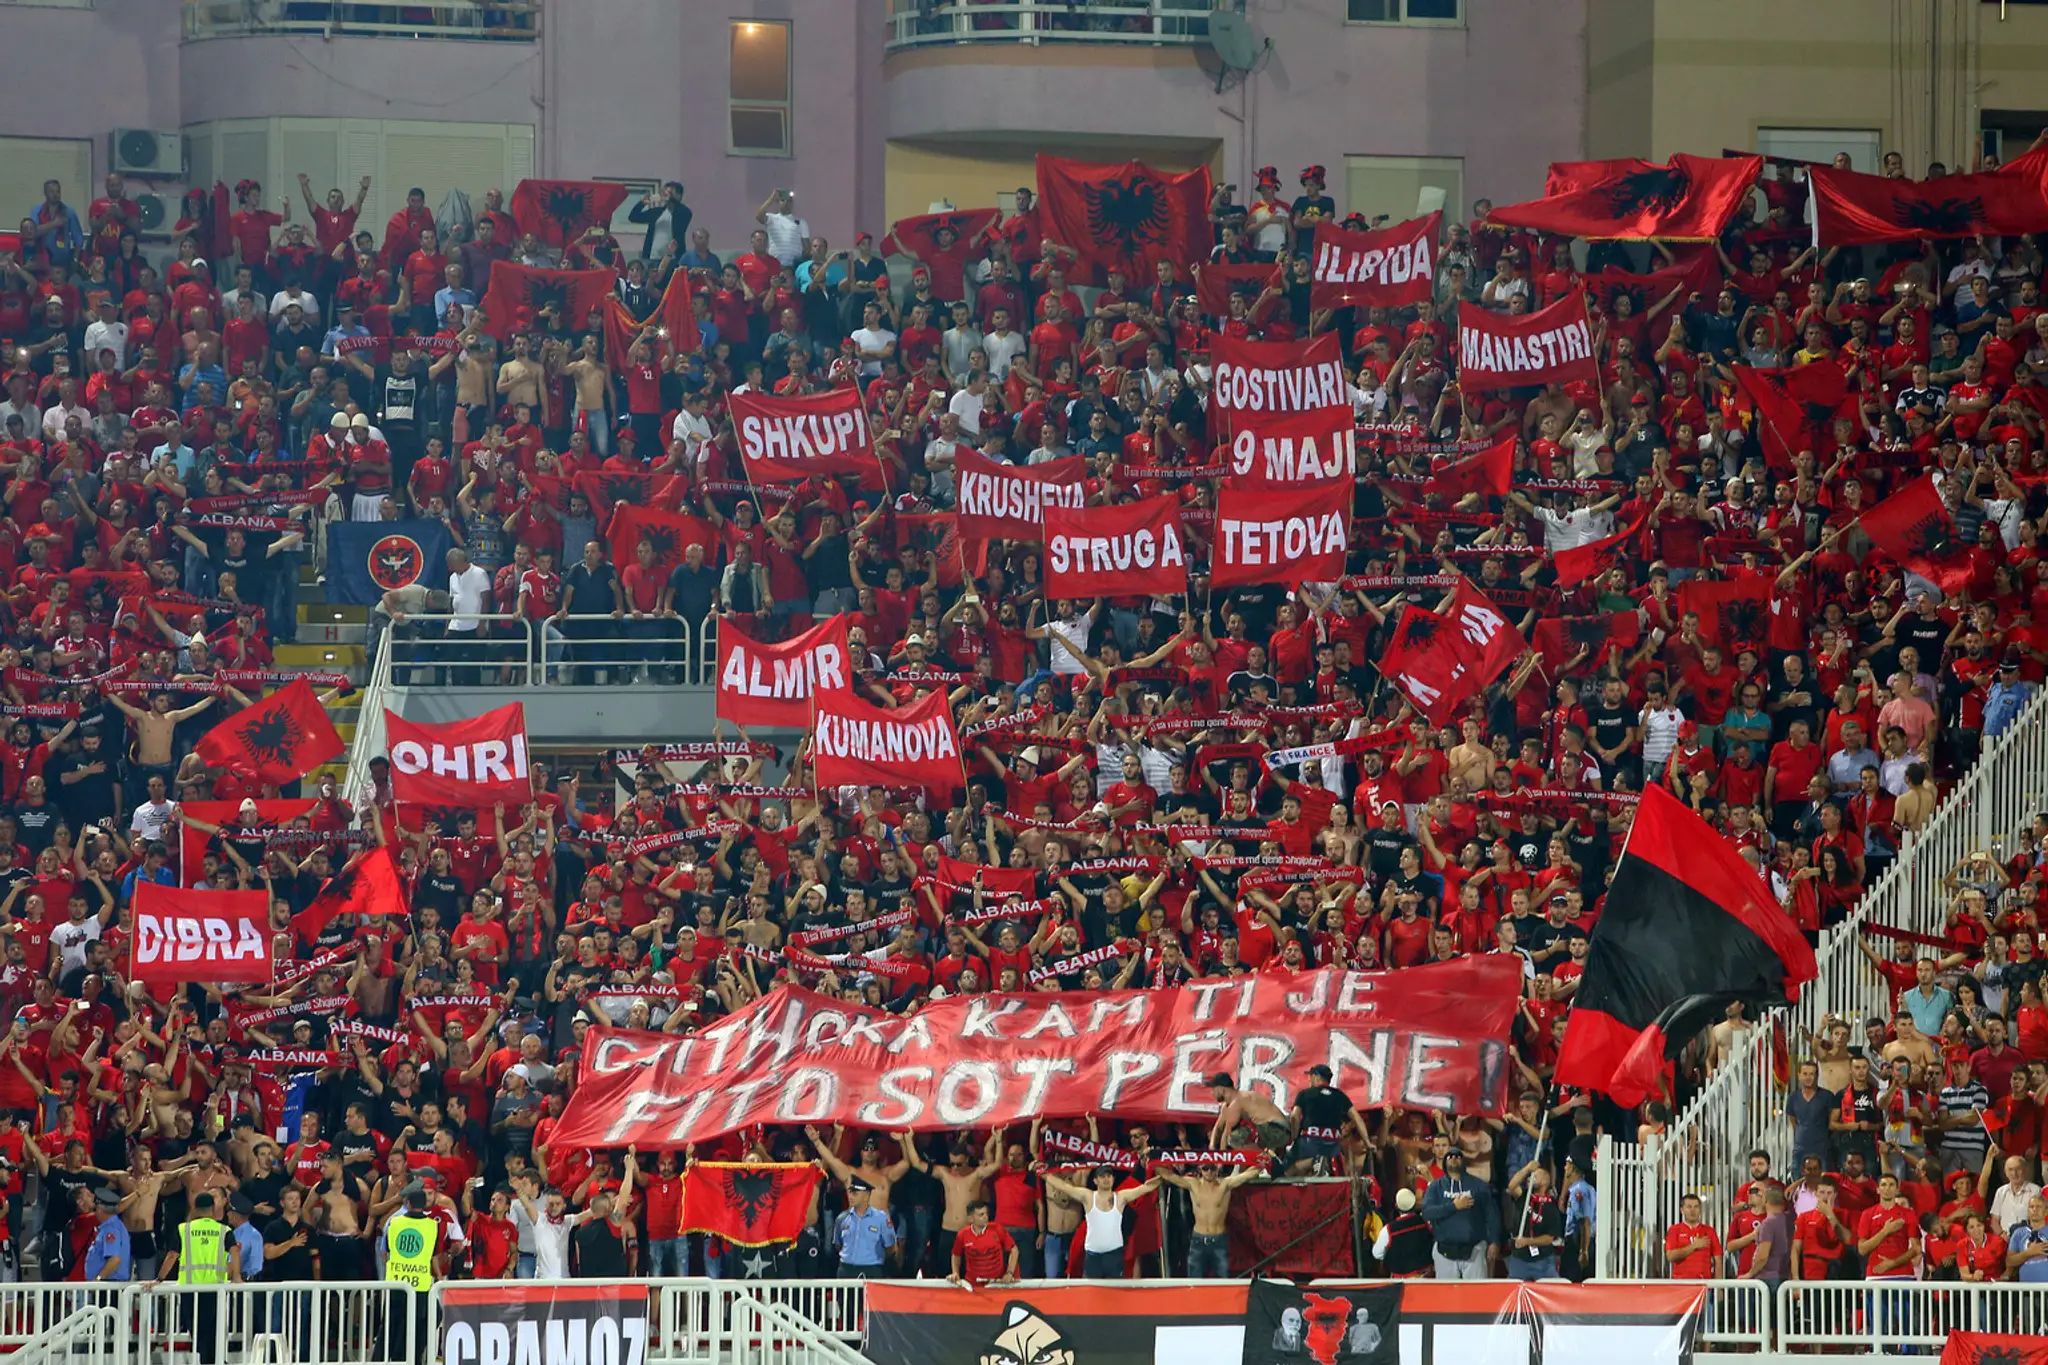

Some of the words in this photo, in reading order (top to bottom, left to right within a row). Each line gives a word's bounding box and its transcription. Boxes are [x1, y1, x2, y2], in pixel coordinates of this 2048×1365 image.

[1461, 319, 1592, 372] MANASTIRI
[1216, 360, 1345, 413] GOSTIVARI
[742, 406, 867, 461] SHKUPI
[1355, 422, 1412, 432] LBANIA
[1232, 432, 1256, 477] 9
[1264, 428, 1355, 482] MAJI
[1391, 473, 1434, 483] ALBA
[199, 514, 276, 528] ALBANIA
[1050, 522, 1184, 574] STRUGA
[1220, 510, 1346, 565] TETOVA
[721, 643, 845, 699] ALMIR
[886, 671, 962, 682] ALBANIA
[815, 709, 957, 762] KUMANOVA
[966, 709, 1037, 737] ALBANIA
[391, 732, 528, 785] OHRI
[664, 742, 751, 755] ALBANIA
[1370, 794, 1382, 816] 5
[1070, 858, 1150, 871] ALBANIA
[964, 900, 1043, 921] ALBANIA
[137, 914, 265, 964] DIBRA
[274, 952, 338, 983] LBANIA
[1028, 944, 1120, 982] ALBANIA
[411, 995, 492, 1008] ALBANIA
[599, 984, 679, 997] ALBANIA
[961, 994, 1149, 1038] KAM
[1188, 977, 1258, 1020] TI
[1286, 970, 1385, 1014] JE
[329, 1019, 410, 1045] ALBANIA
[248, 1049, 329, 1063] ALBANIA
[858, 1056, 1074, 1125] SOT
[1045, 1130, 1131, 1161] ALBANIA
[1160, 1150, 1247, 1162] ALBANIA
[390, 1262, 428, 1273] TEWARD
